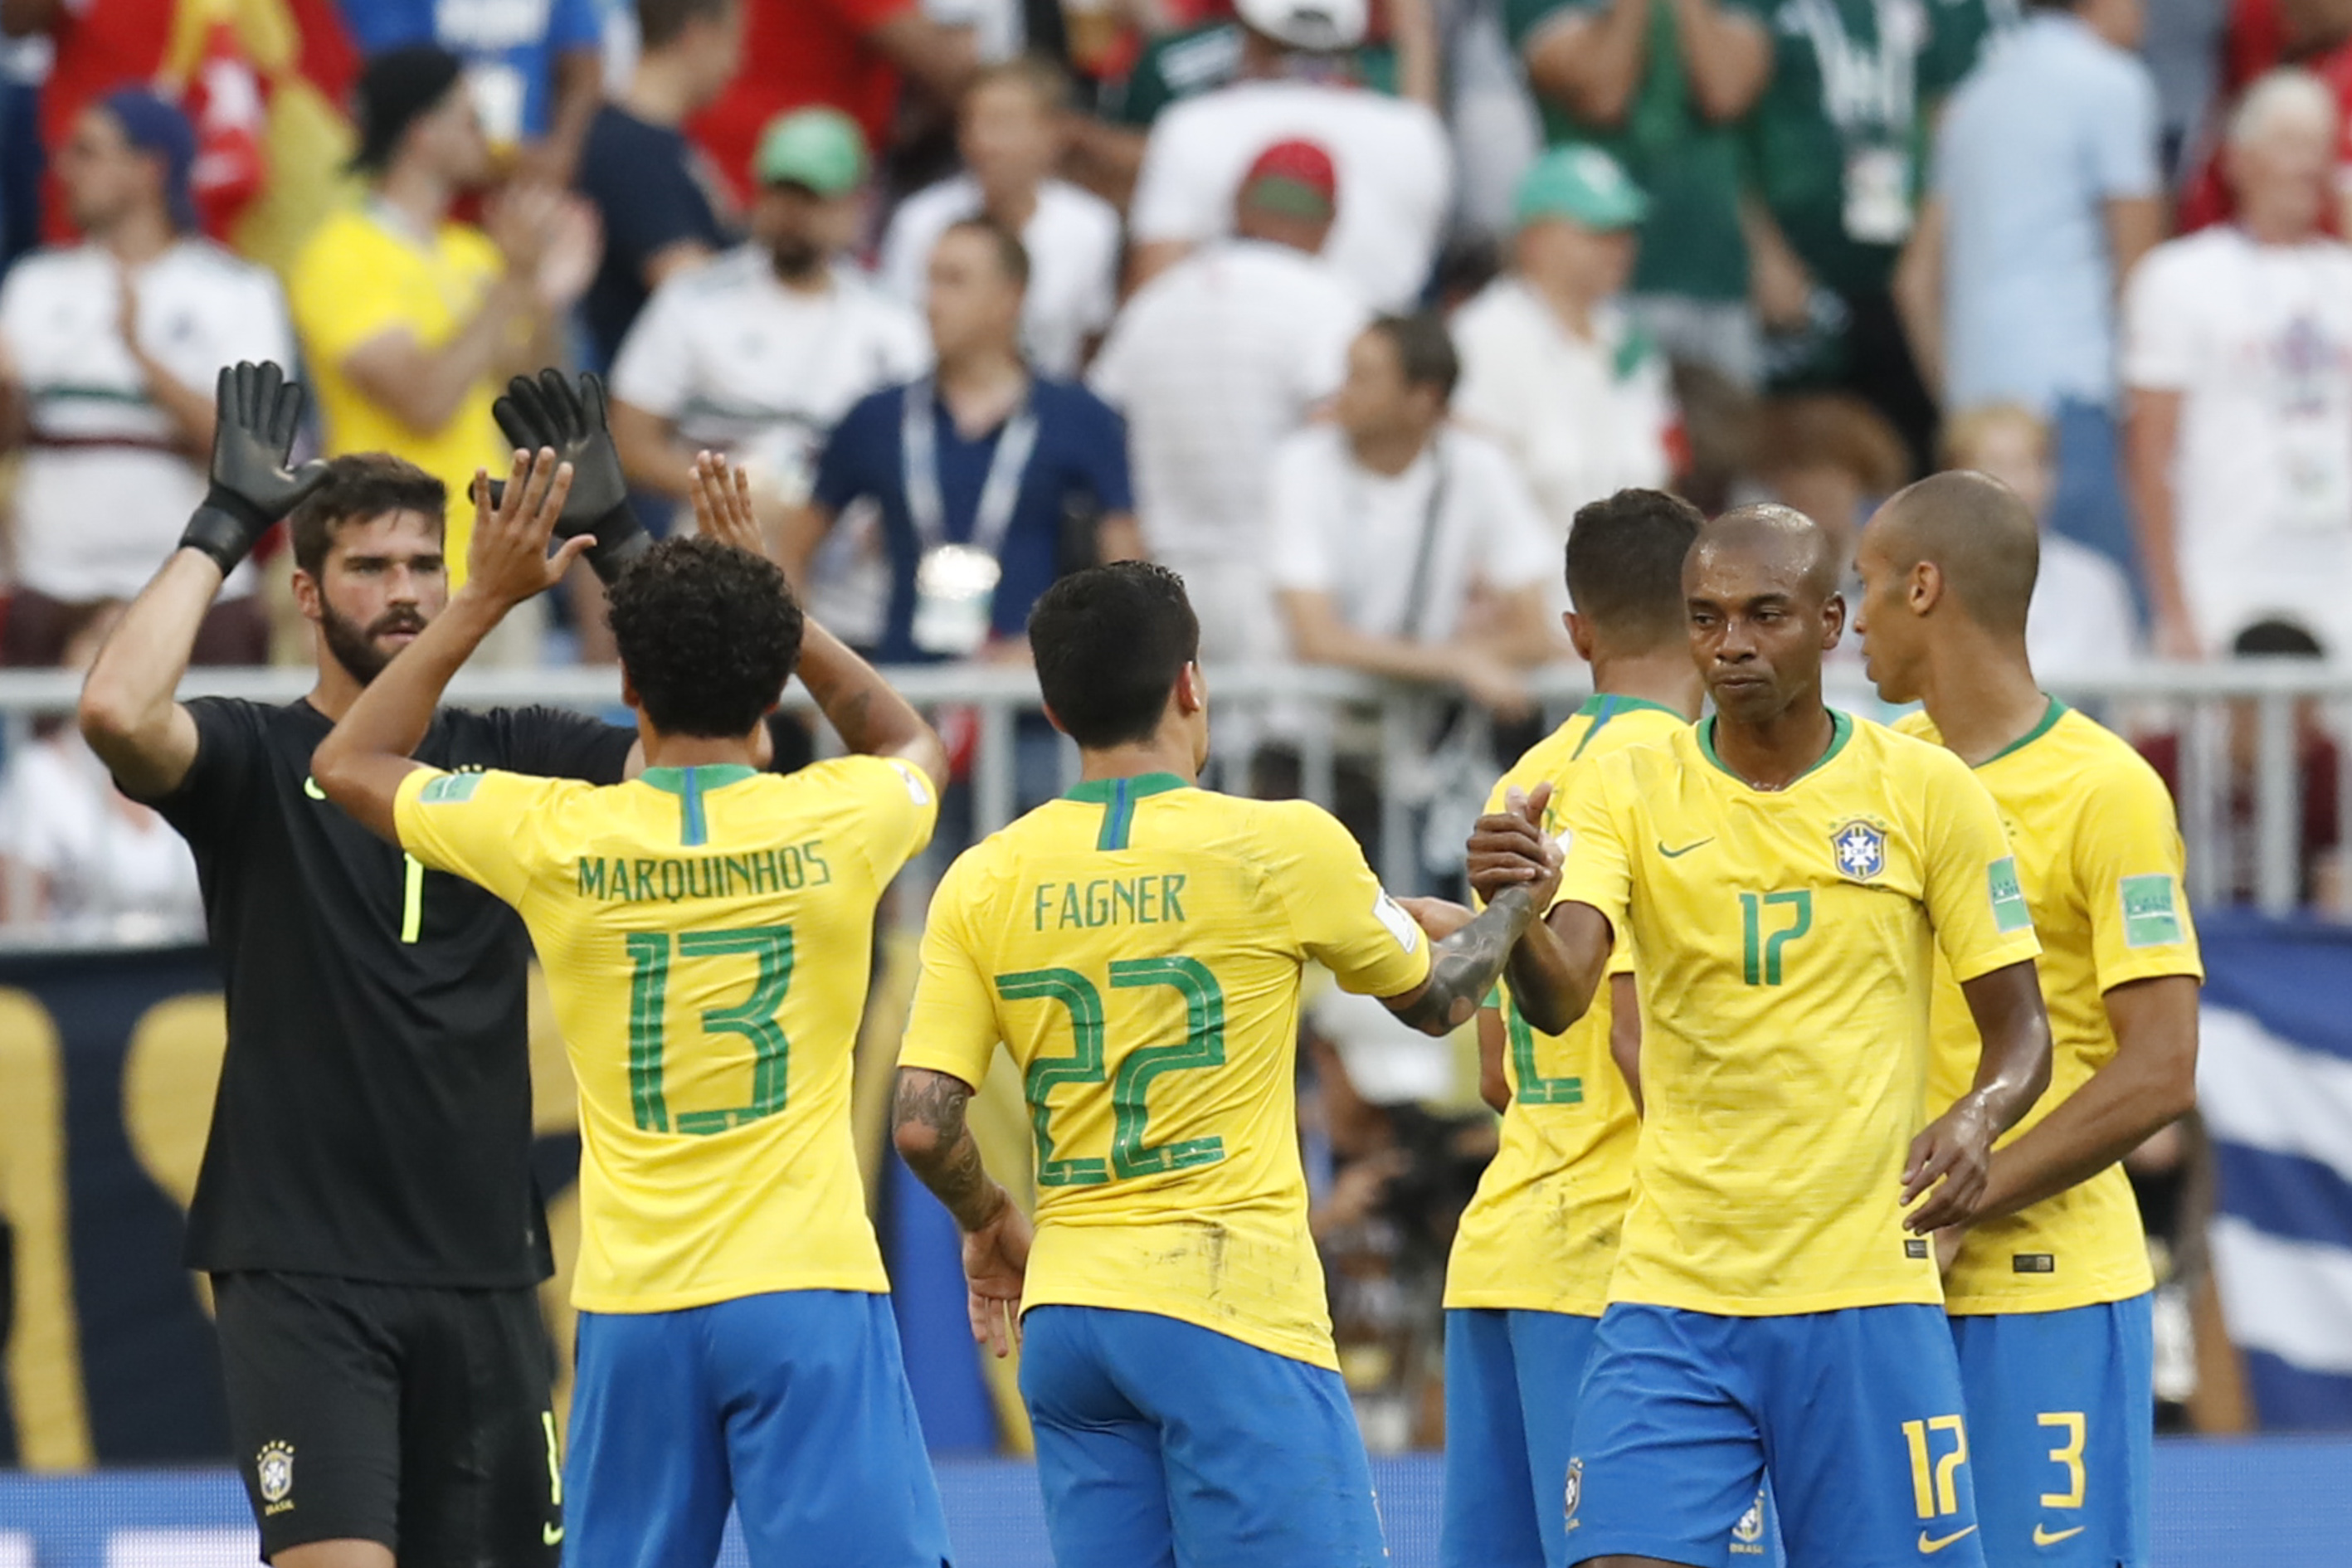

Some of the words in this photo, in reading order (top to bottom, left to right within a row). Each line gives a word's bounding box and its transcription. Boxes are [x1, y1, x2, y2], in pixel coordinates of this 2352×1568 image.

[402, 852, 424, 943] 1
[577, 840, 830, 903] MARQUINHOS
[1035, 874, 1186, 930] FAGNER
[1740, 890, 1811, 985] 17
[626, 924, 794, 1134] 13
[995, 957, 1225, 1185] 22
[1902, 1415, 1966, 1519] 17
[2038, 1412, 2087, 1508] 3
